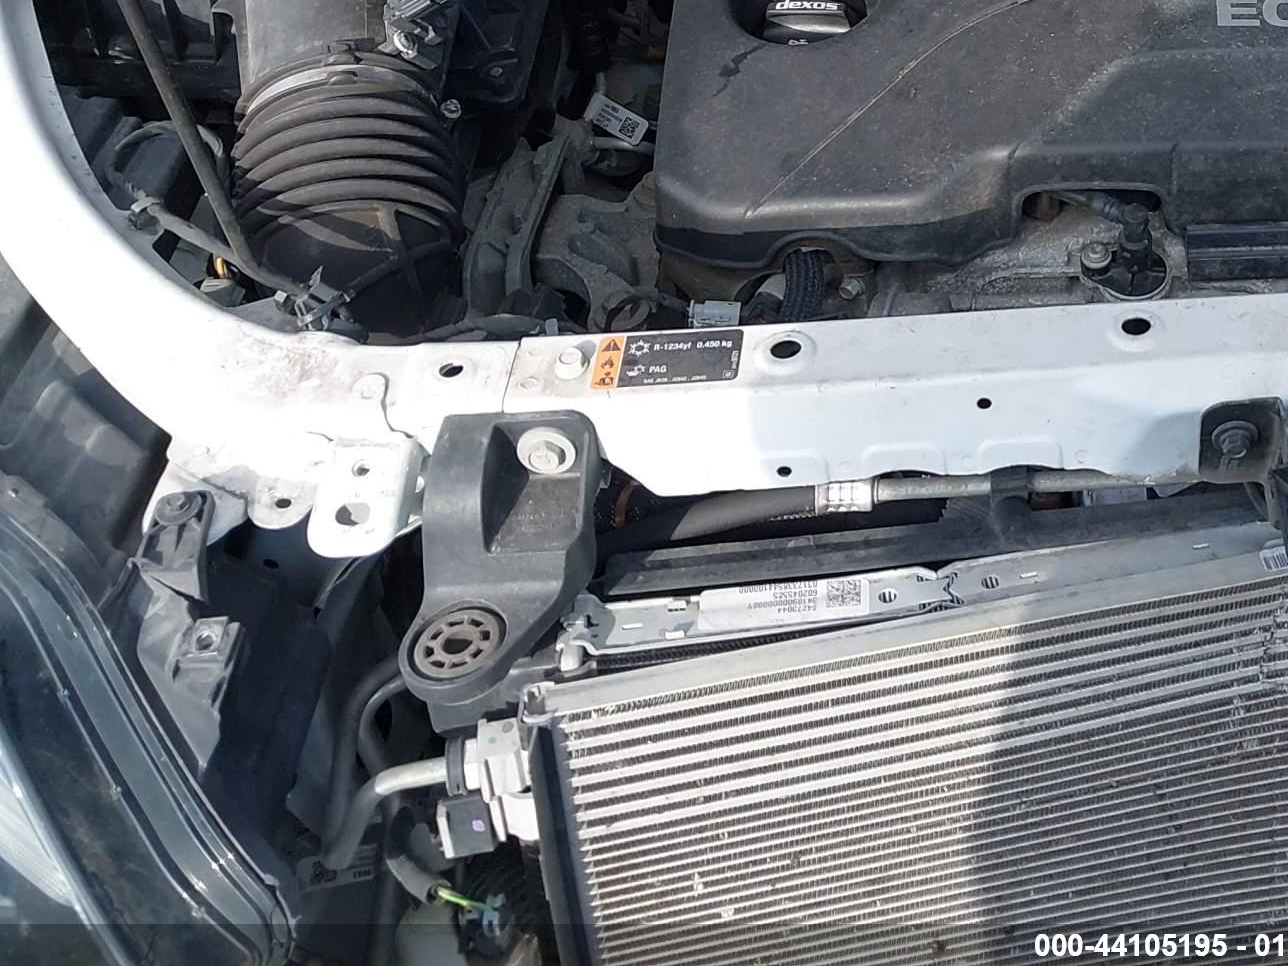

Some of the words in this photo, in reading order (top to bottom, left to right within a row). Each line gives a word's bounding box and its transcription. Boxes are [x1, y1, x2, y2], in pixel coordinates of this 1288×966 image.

[775, 0, 841, 10] dexos
[696, 340, 720, 349] 0.450
[721, 339, 733, 348] kg
[649, 365, 667, 374] PAG
